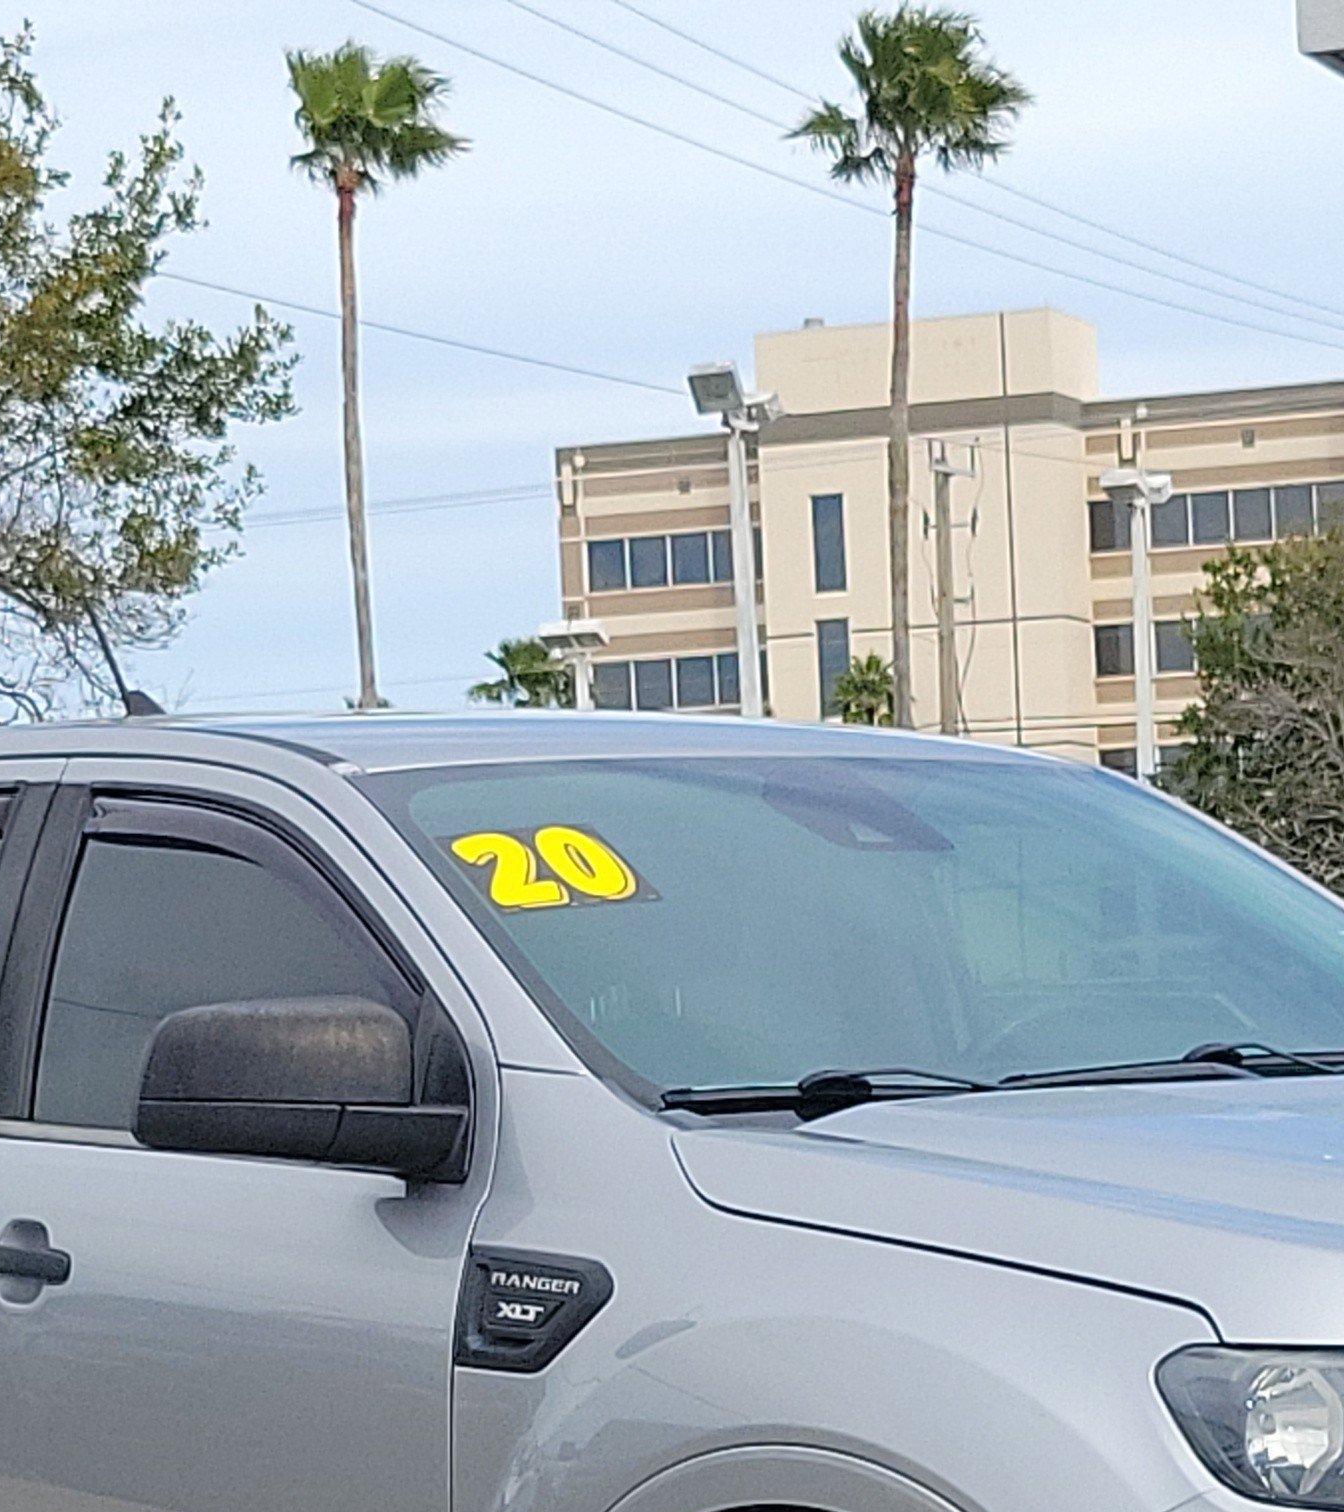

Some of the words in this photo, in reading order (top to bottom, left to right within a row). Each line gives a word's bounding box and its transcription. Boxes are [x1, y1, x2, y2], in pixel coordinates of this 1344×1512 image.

[451, 825, 637, 908] 20
[490, 1271, 581, 1295] RANGER
[495, 1300, 545, 1323] XLT
